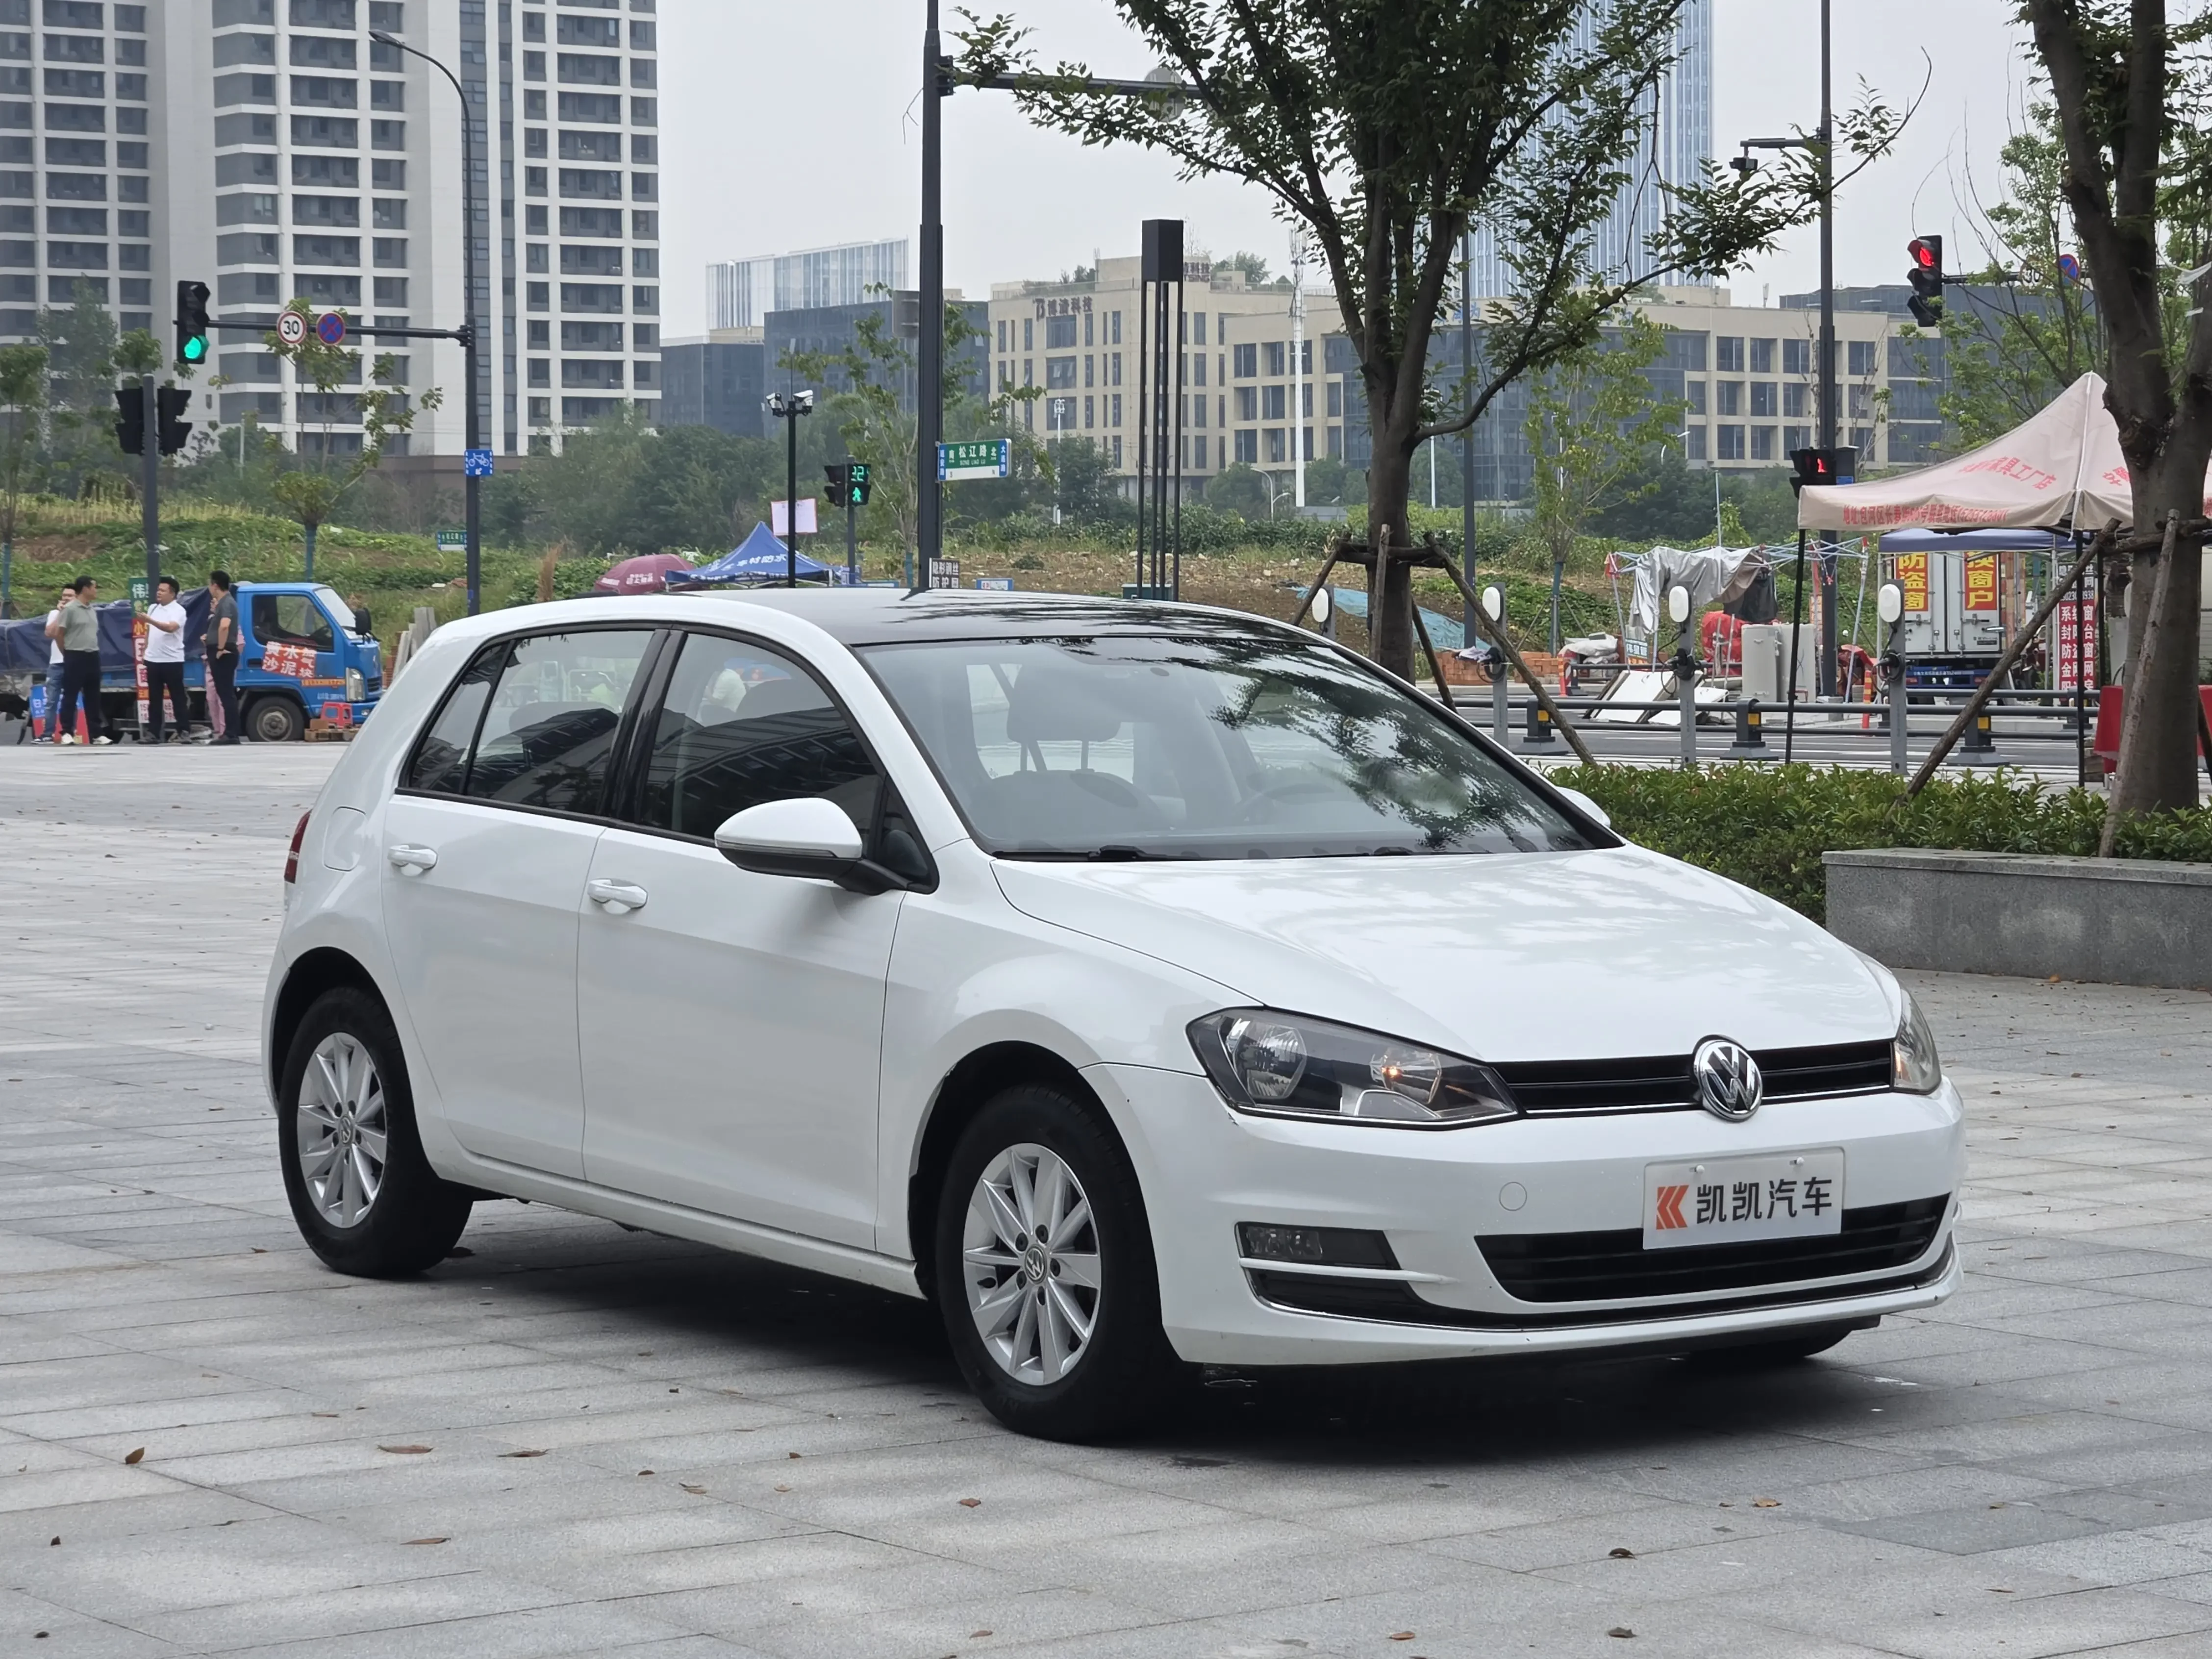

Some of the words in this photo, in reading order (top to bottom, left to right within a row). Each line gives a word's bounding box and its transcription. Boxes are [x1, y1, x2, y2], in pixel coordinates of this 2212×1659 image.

[283, 320, 300, 335] 30
[958, 444, 987, 458] 松辽路
[1898, 553, 1926, 609] 防盗窗
[1696, 1176, 1833, 1224] 凯凯汽车
